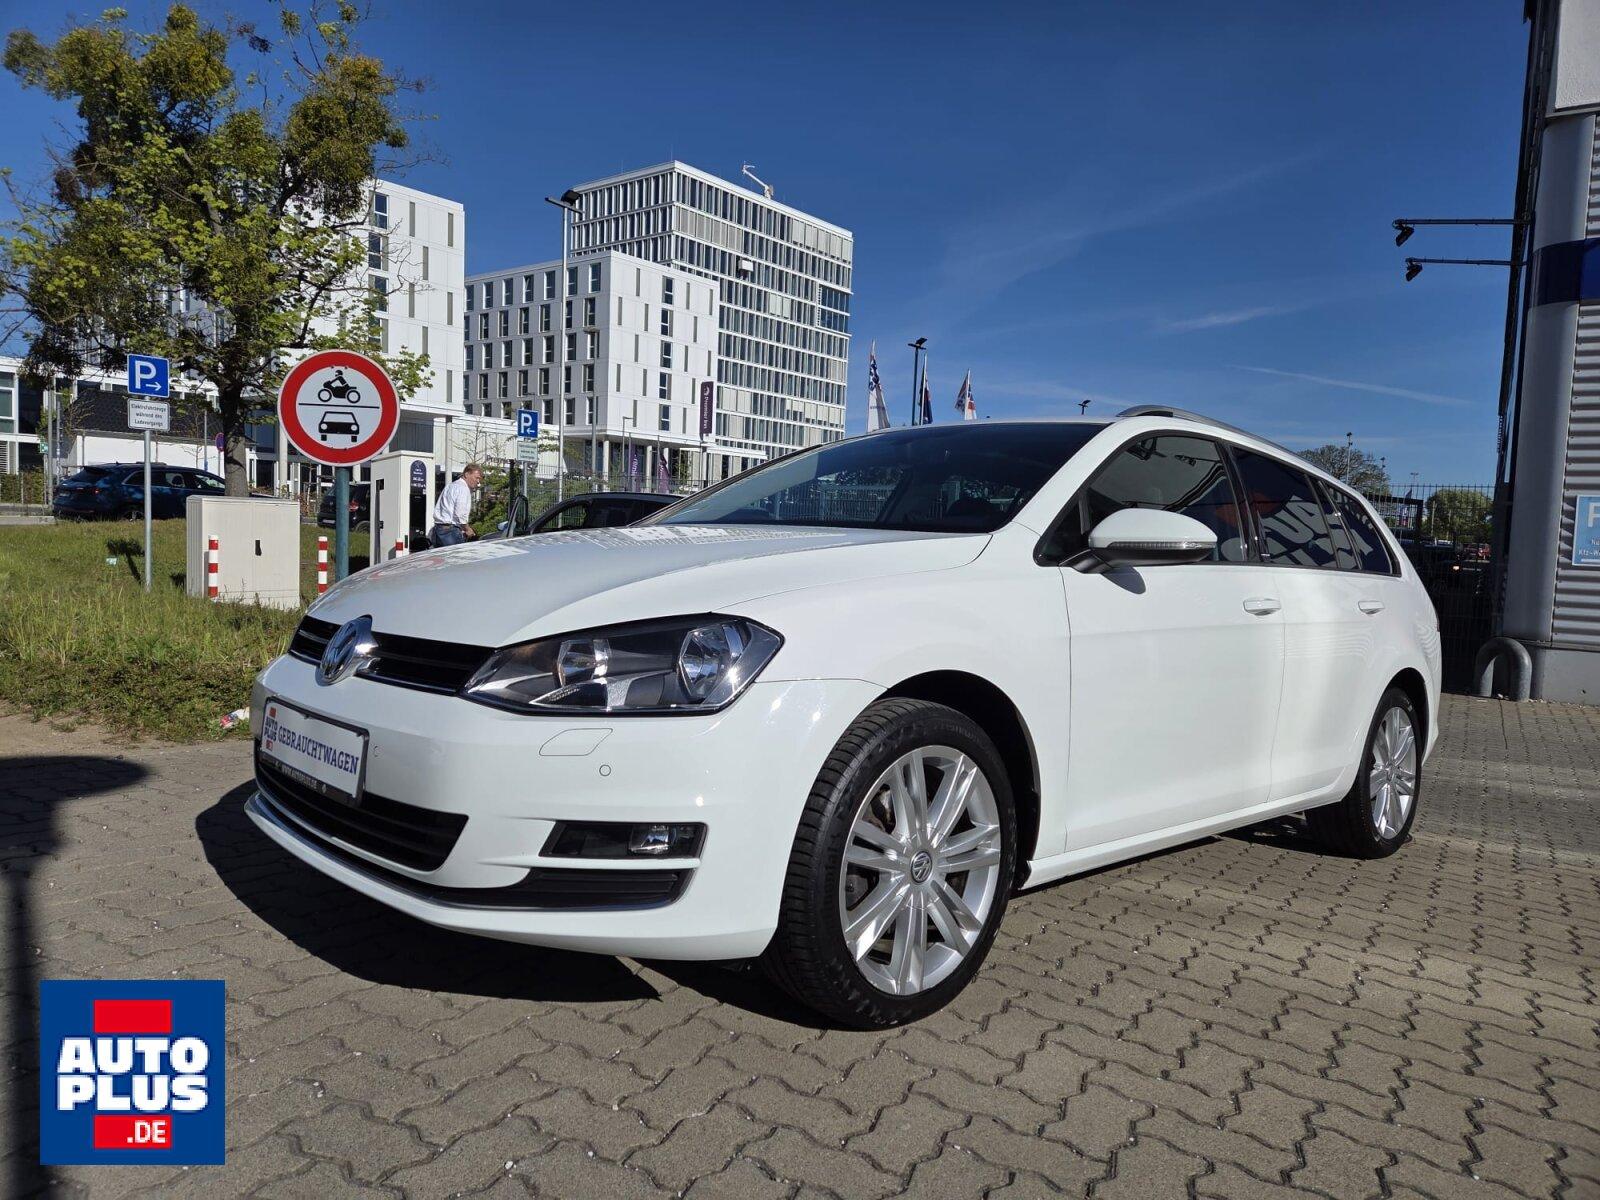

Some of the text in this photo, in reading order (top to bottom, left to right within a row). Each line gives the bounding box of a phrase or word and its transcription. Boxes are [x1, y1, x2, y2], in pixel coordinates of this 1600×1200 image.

[134, 360, 157, 389] P
[520, 413, 533, 434] P
[264, 727, 277, 741] PLUS
[265, 716, 278, 731] AUTO
[278, 725, 360, 775] GEBRAUCHTWAGEN
